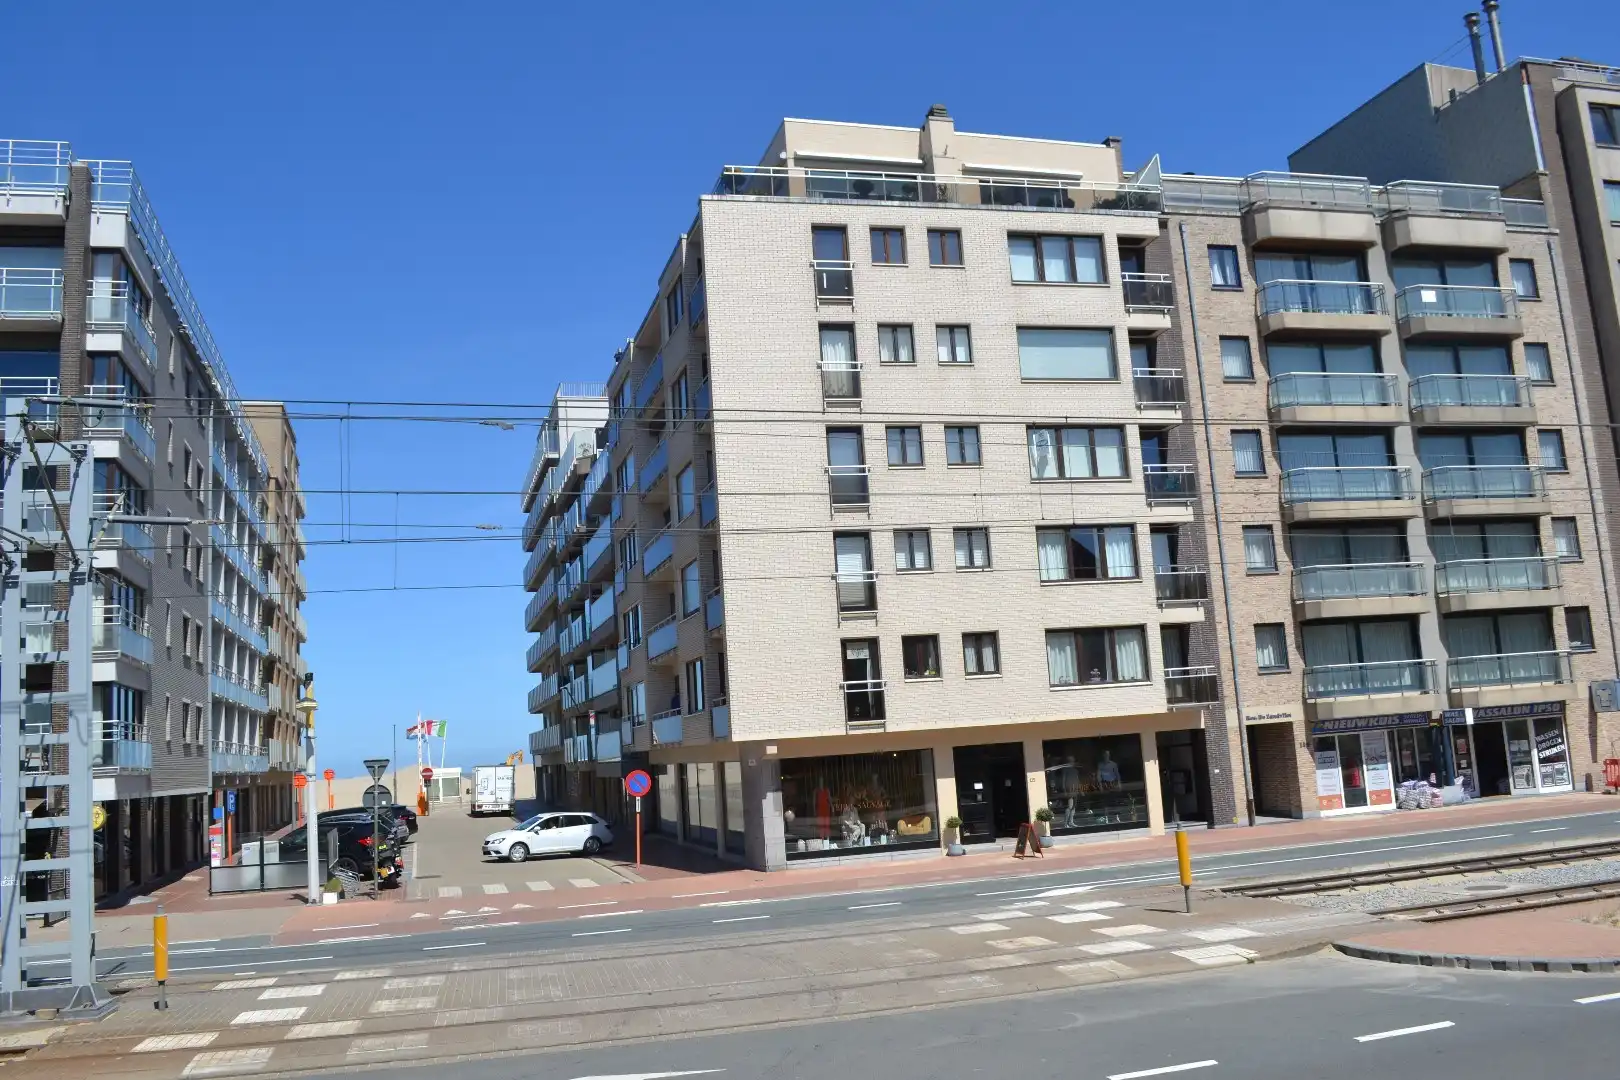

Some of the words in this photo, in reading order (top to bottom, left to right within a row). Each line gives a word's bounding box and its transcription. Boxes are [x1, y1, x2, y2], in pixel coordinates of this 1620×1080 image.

[1533, 703, 1561, 713] IPSO
[1533, 728, 1559, 742] WASSEN
[1537, 736, 1562, 750] DROGEN
